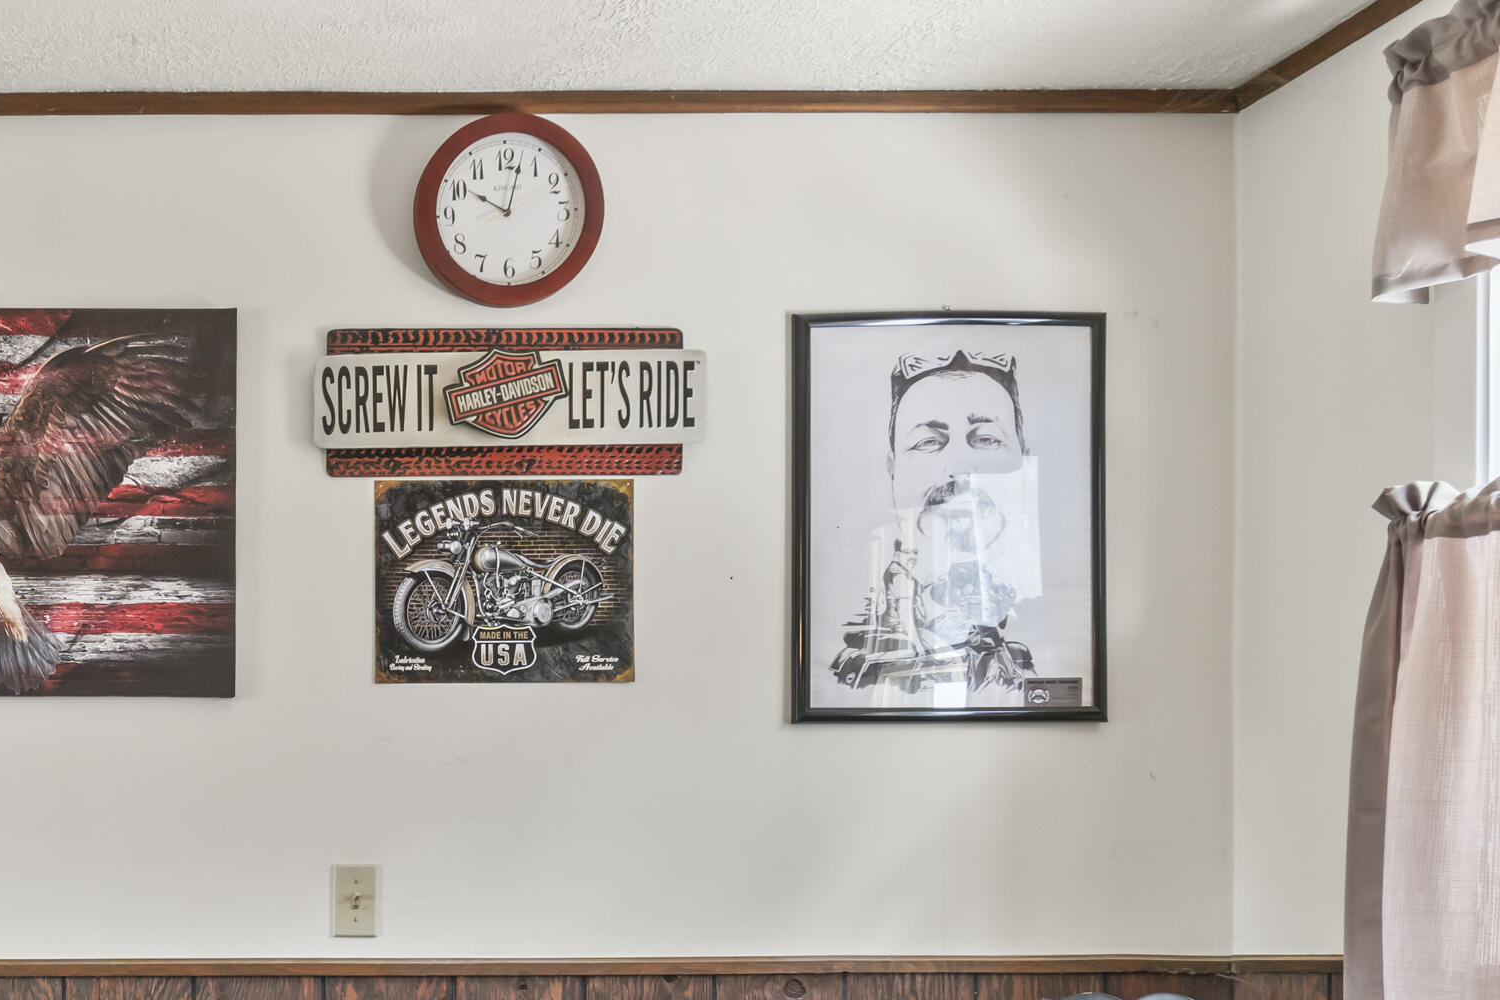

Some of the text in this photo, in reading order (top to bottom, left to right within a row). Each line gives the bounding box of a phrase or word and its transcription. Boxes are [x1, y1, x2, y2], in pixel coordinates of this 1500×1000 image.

[470, 157, 484, 180] 11
[495, 148, 516, 171] 12
[530, 156, 538, 177] 1
[450, 179, 467, 200] 10
[548, 172, 561, 195] 2
[443, 206, 456, 226] 9
[557, 200, 571, 222] 3
[453, 233, 467, 254] 8
[548, 229, 563, 248] 4
[474, 254, 488, 273] 7
[503, 258, 516, 278] 6
[529, 249, 543, 270] 5
[475, 359, 527, 385] MOTOR
[321, 364, 438, 435] SCREW IT
[457, 371, 555, 413] HARLEY-DAVIDSON
[568, 360, 696, 429] LET'S RIDE
[484, 400, 538, 429] CYCLES
[381, 488, 628, 559] LEGENDS NEVER DIE
[480, 631, 529, 640] MADE IN THE
[480, 643, 528, 666] USA
